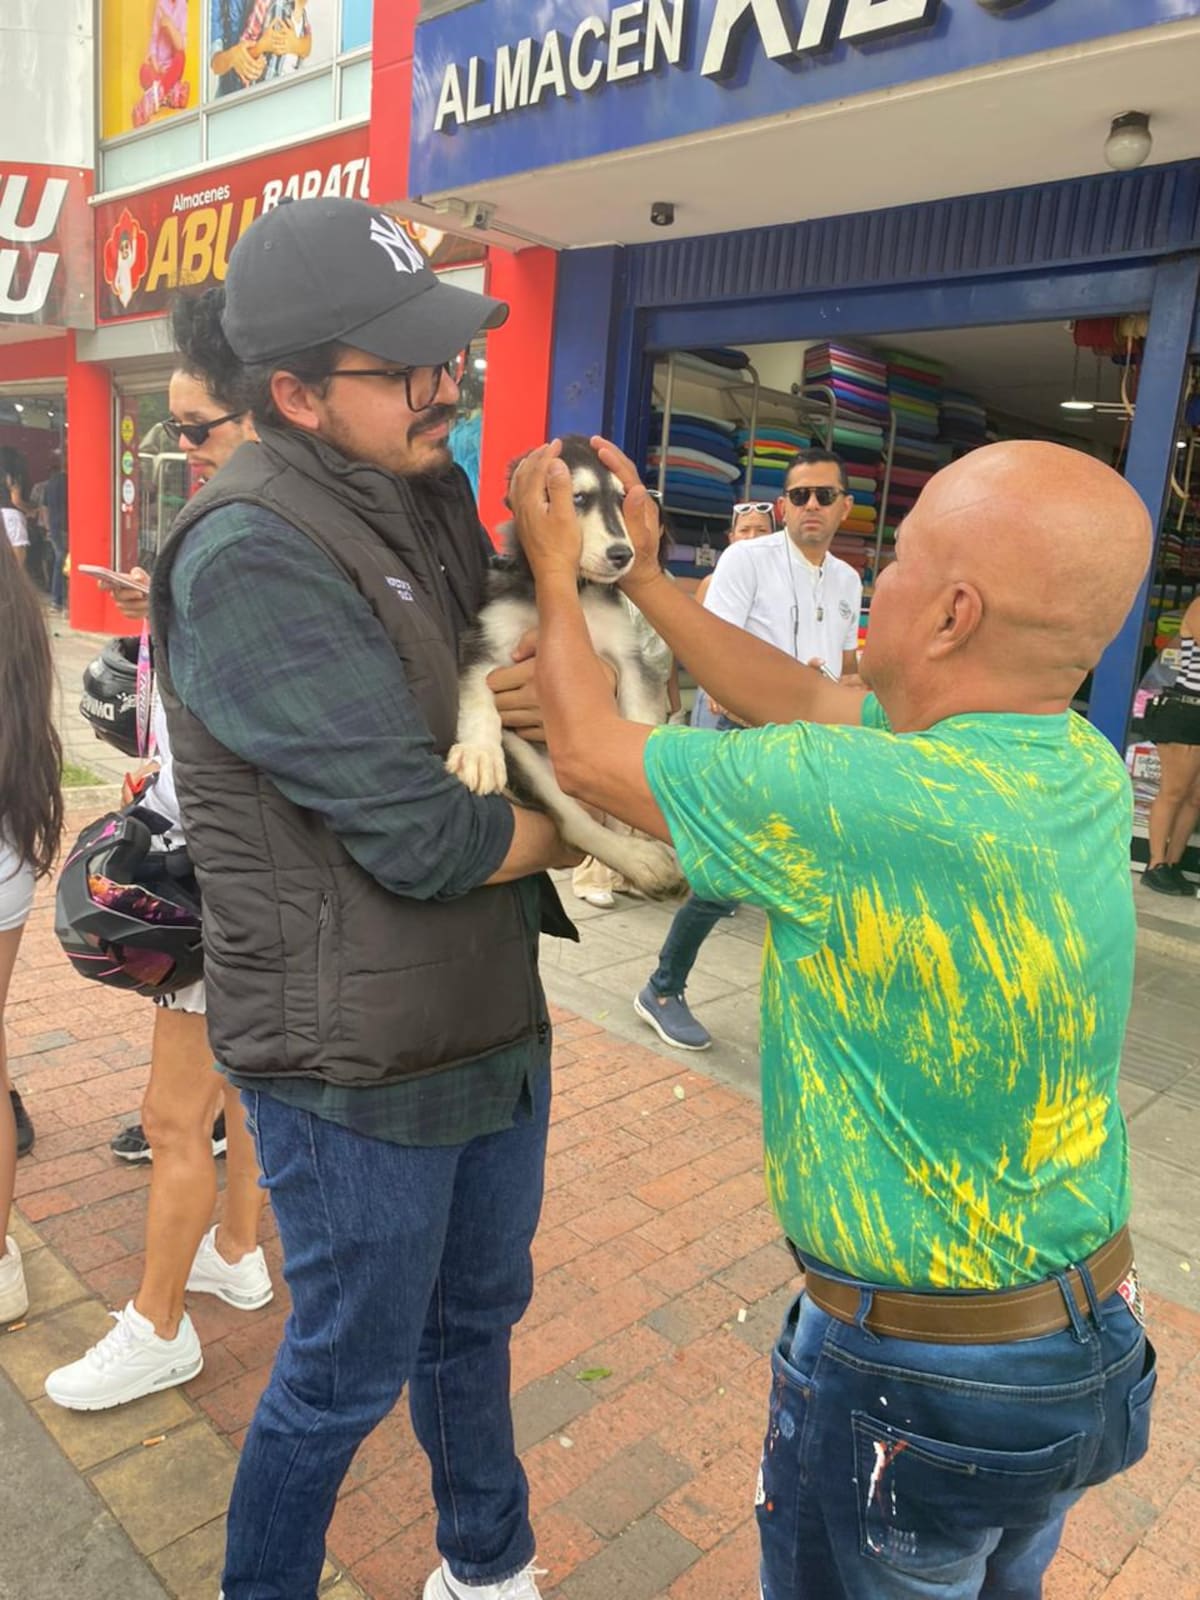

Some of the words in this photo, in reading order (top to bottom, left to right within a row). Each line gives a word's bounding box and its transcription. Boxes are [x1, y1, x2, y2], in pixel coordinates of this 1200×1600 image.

[433, 0, 684, 131] ALMACEN
[144, 196, 258, 292] ABU
[172, 184, 231, 213] Almacenes
